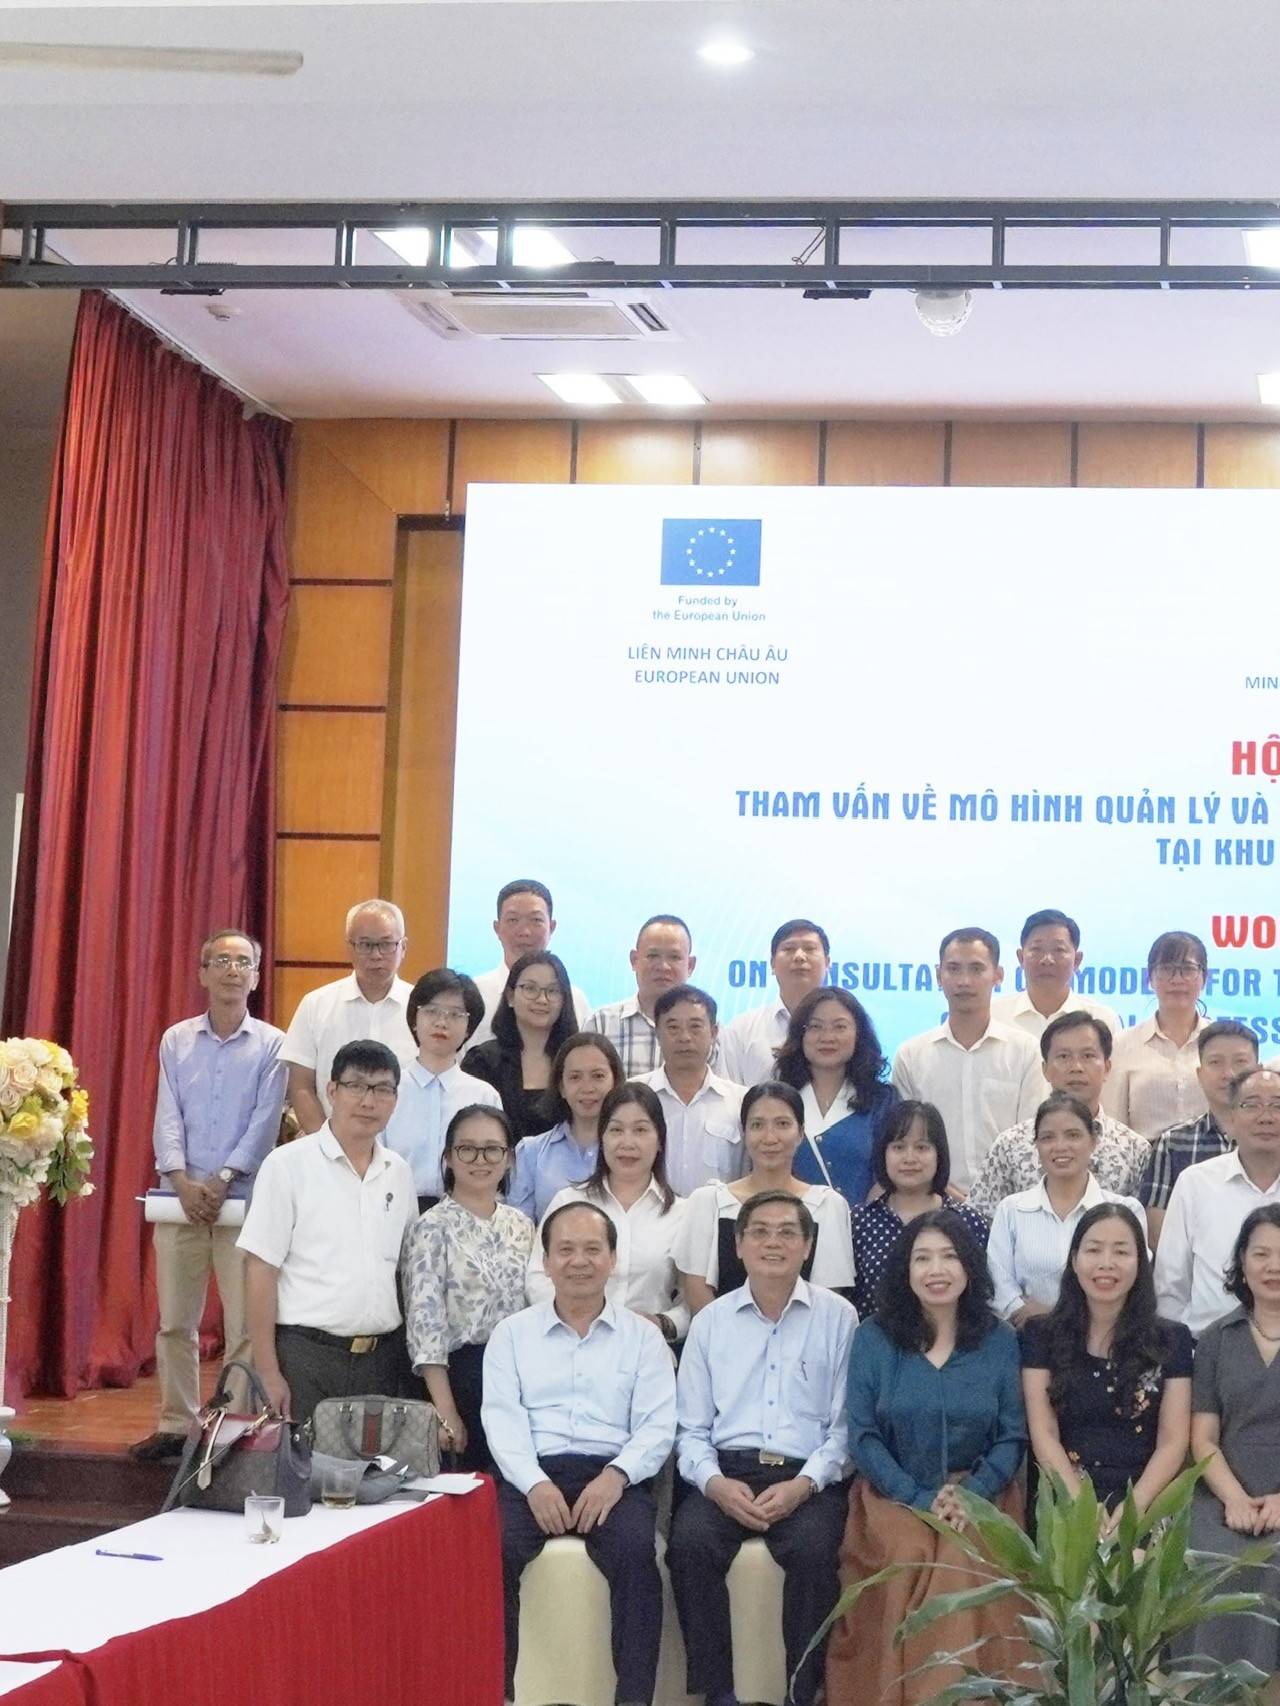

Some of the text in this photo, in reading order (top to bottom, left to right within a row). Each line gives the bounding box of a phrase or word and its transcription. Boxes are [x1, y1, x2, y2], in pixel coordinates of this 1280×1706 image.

[678, 595, 738, 607] Funded by
[653, 609, 766, 622] the European Union
[628, 643, 788, 661] LIÊN MINH CHÂU ÂU
[635, 670, 780, 686] EUROPEAN UNION
[736, 790, 820, 819] THAM
[832, 782, 890, 820] VẤN
[902, 782, 937, 821] VỀ
[949, 789, 998, 822] MÔ
[1011, 789, 1082, 823] HÌNH
[1096, 788, 1175, 825] QUẢN
[1189, 791, 1220, 824] LÝ
[1231, 792, 1269, 825] VÀ
[1155, 837, 1201, 873] TẠI
[1215, 838, 1275, 867] KHU
[728, 960, 767, 988] ON
[1206, 968, 1261, 996] FOR
